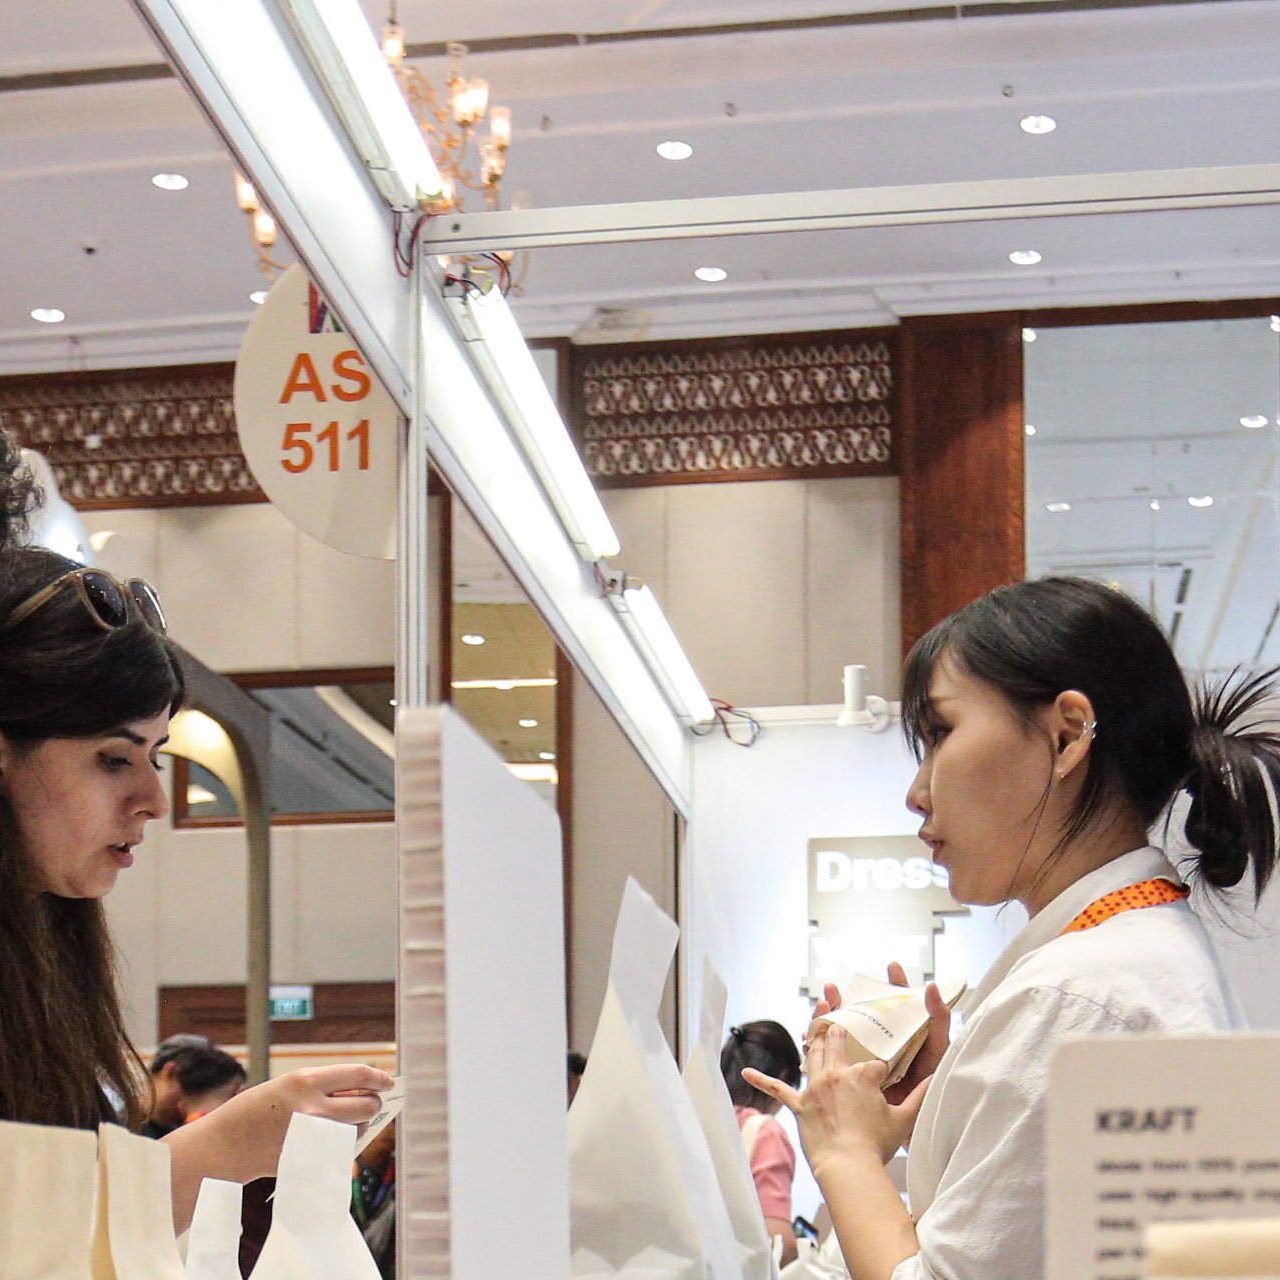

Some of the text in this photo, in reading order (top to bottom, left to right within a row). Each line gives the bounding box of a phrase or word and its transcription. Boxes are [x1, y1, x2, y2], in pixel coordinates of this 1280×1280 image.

[279, 350, 371, 403] AS
[281, 419, 370, 473] 511
[868, 1016, 895, 1039] COFFEE
[1096, 1107, 1197, 1132] KRAFT
